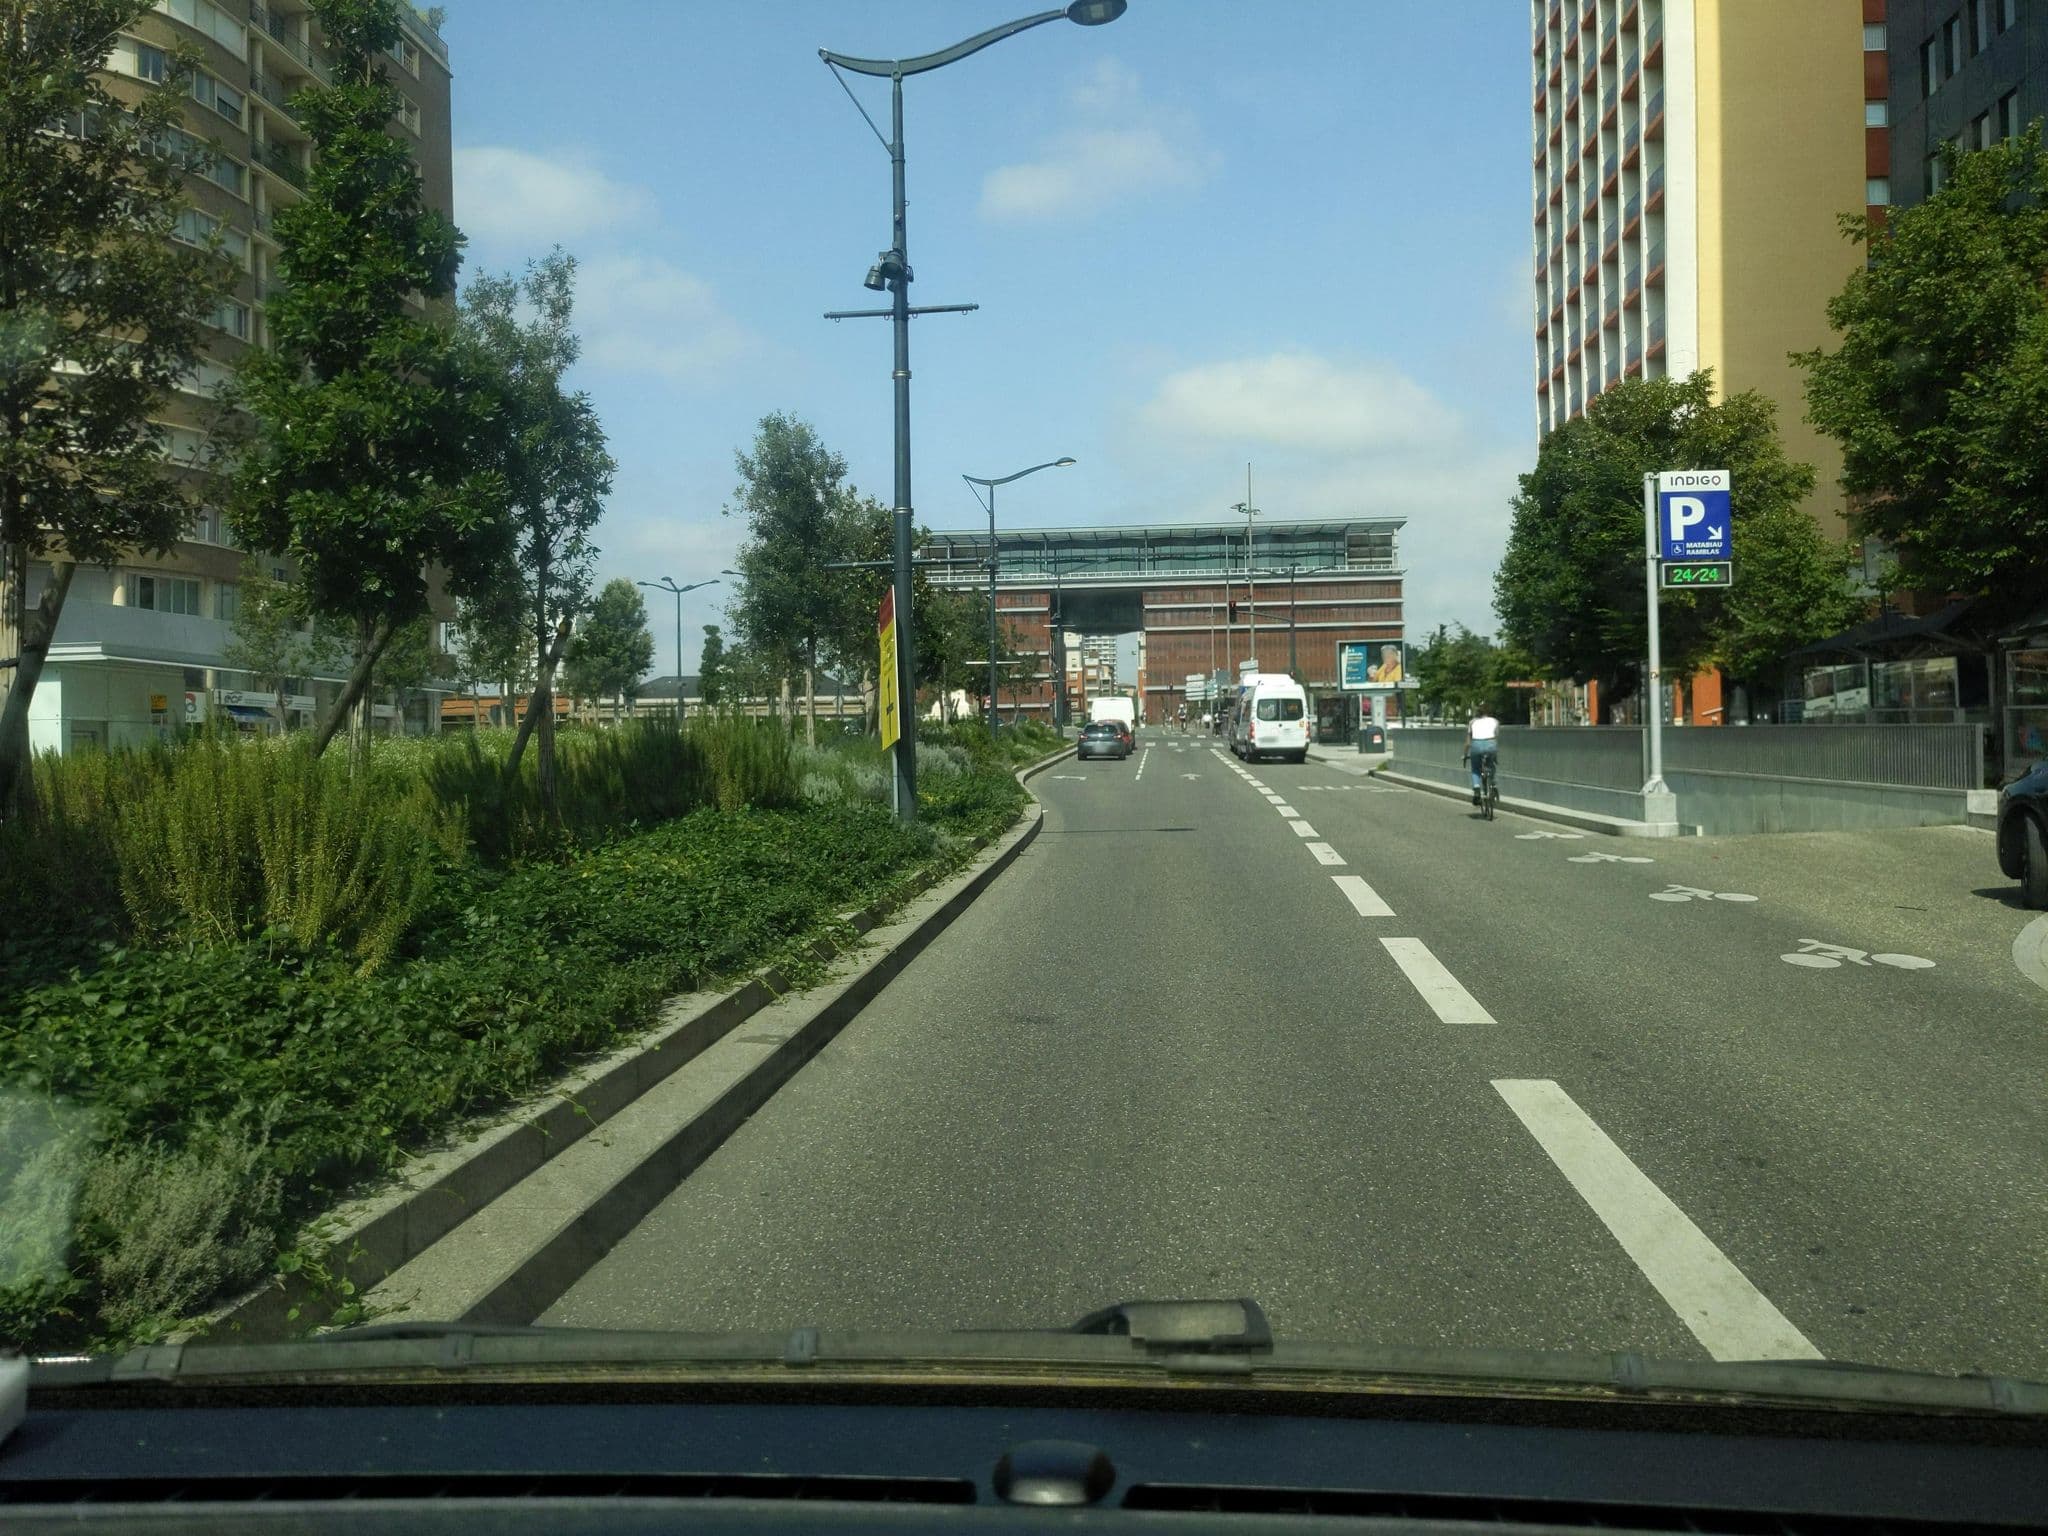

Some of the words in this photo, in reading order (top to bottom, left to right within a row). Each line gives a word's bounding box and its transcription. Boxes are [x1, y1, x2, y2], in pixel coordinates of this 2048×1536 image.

[1670, 475, 1721, 486] INDIGO
[1669, 497, 1705, 541] P
[1672, 568, 1719, 582] 24/24
